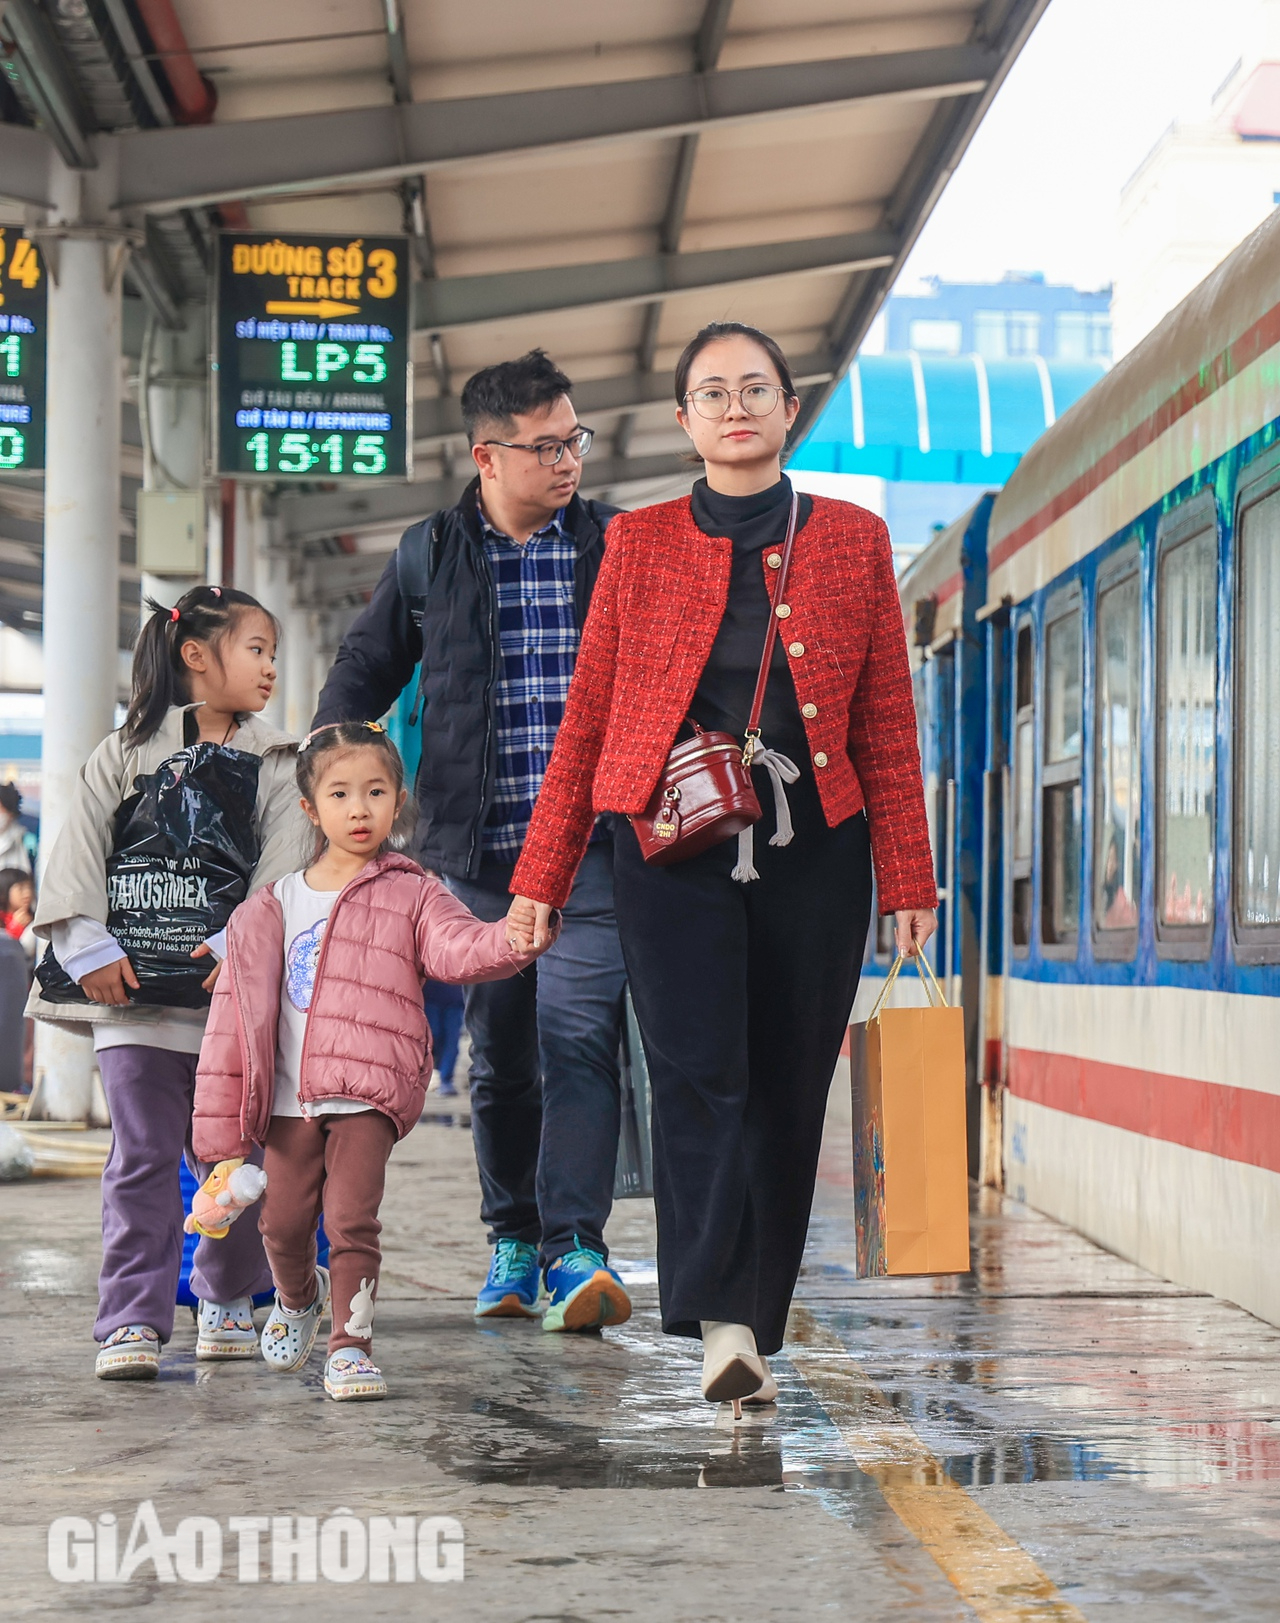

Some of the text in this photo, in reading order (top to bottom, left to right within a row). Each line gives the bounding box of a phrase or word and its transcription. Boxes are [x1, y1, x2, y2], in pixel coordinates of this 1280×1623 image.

[8, 238, 40, 289] 4
[232, 239, 398, 299] ĐƯỜNG SỐ 3
[286, 276, 361, 299] TRACK
[281, 341, 387, 382] LP5
[246, 432, 386, 474] 15:15
